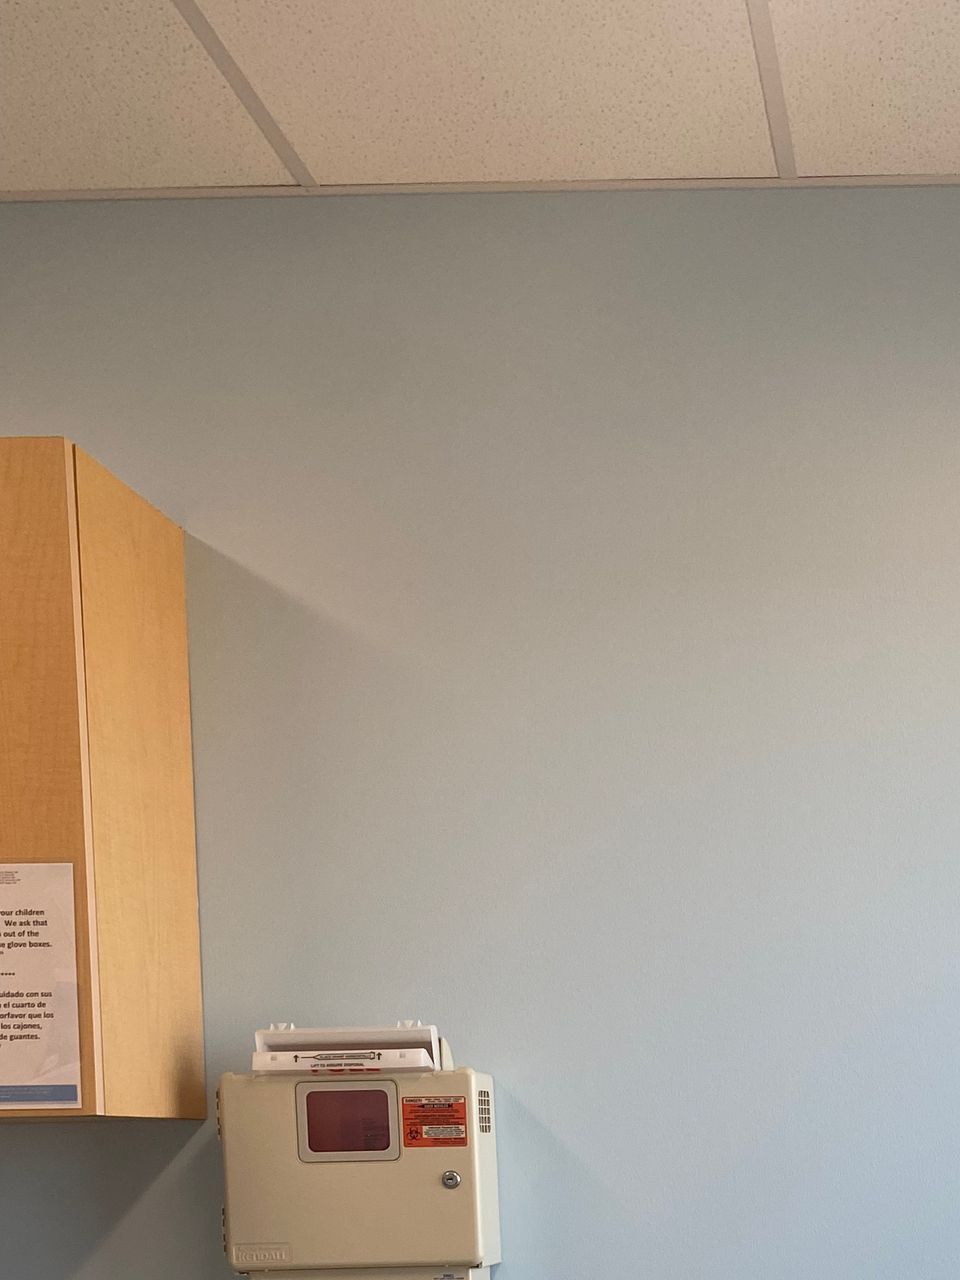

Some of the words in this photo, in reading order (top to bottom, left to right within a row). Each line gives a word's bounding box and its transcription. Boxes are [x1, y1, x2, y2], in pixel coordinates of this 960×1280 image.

[7, 941, 27, 949] glove
[43, 1011, 54, 1019] los
[1, 1022, 12, 1030] los
[12, 1022, 43, 1031] cajones,
[9, 1033, 41, 1041] guantes.
